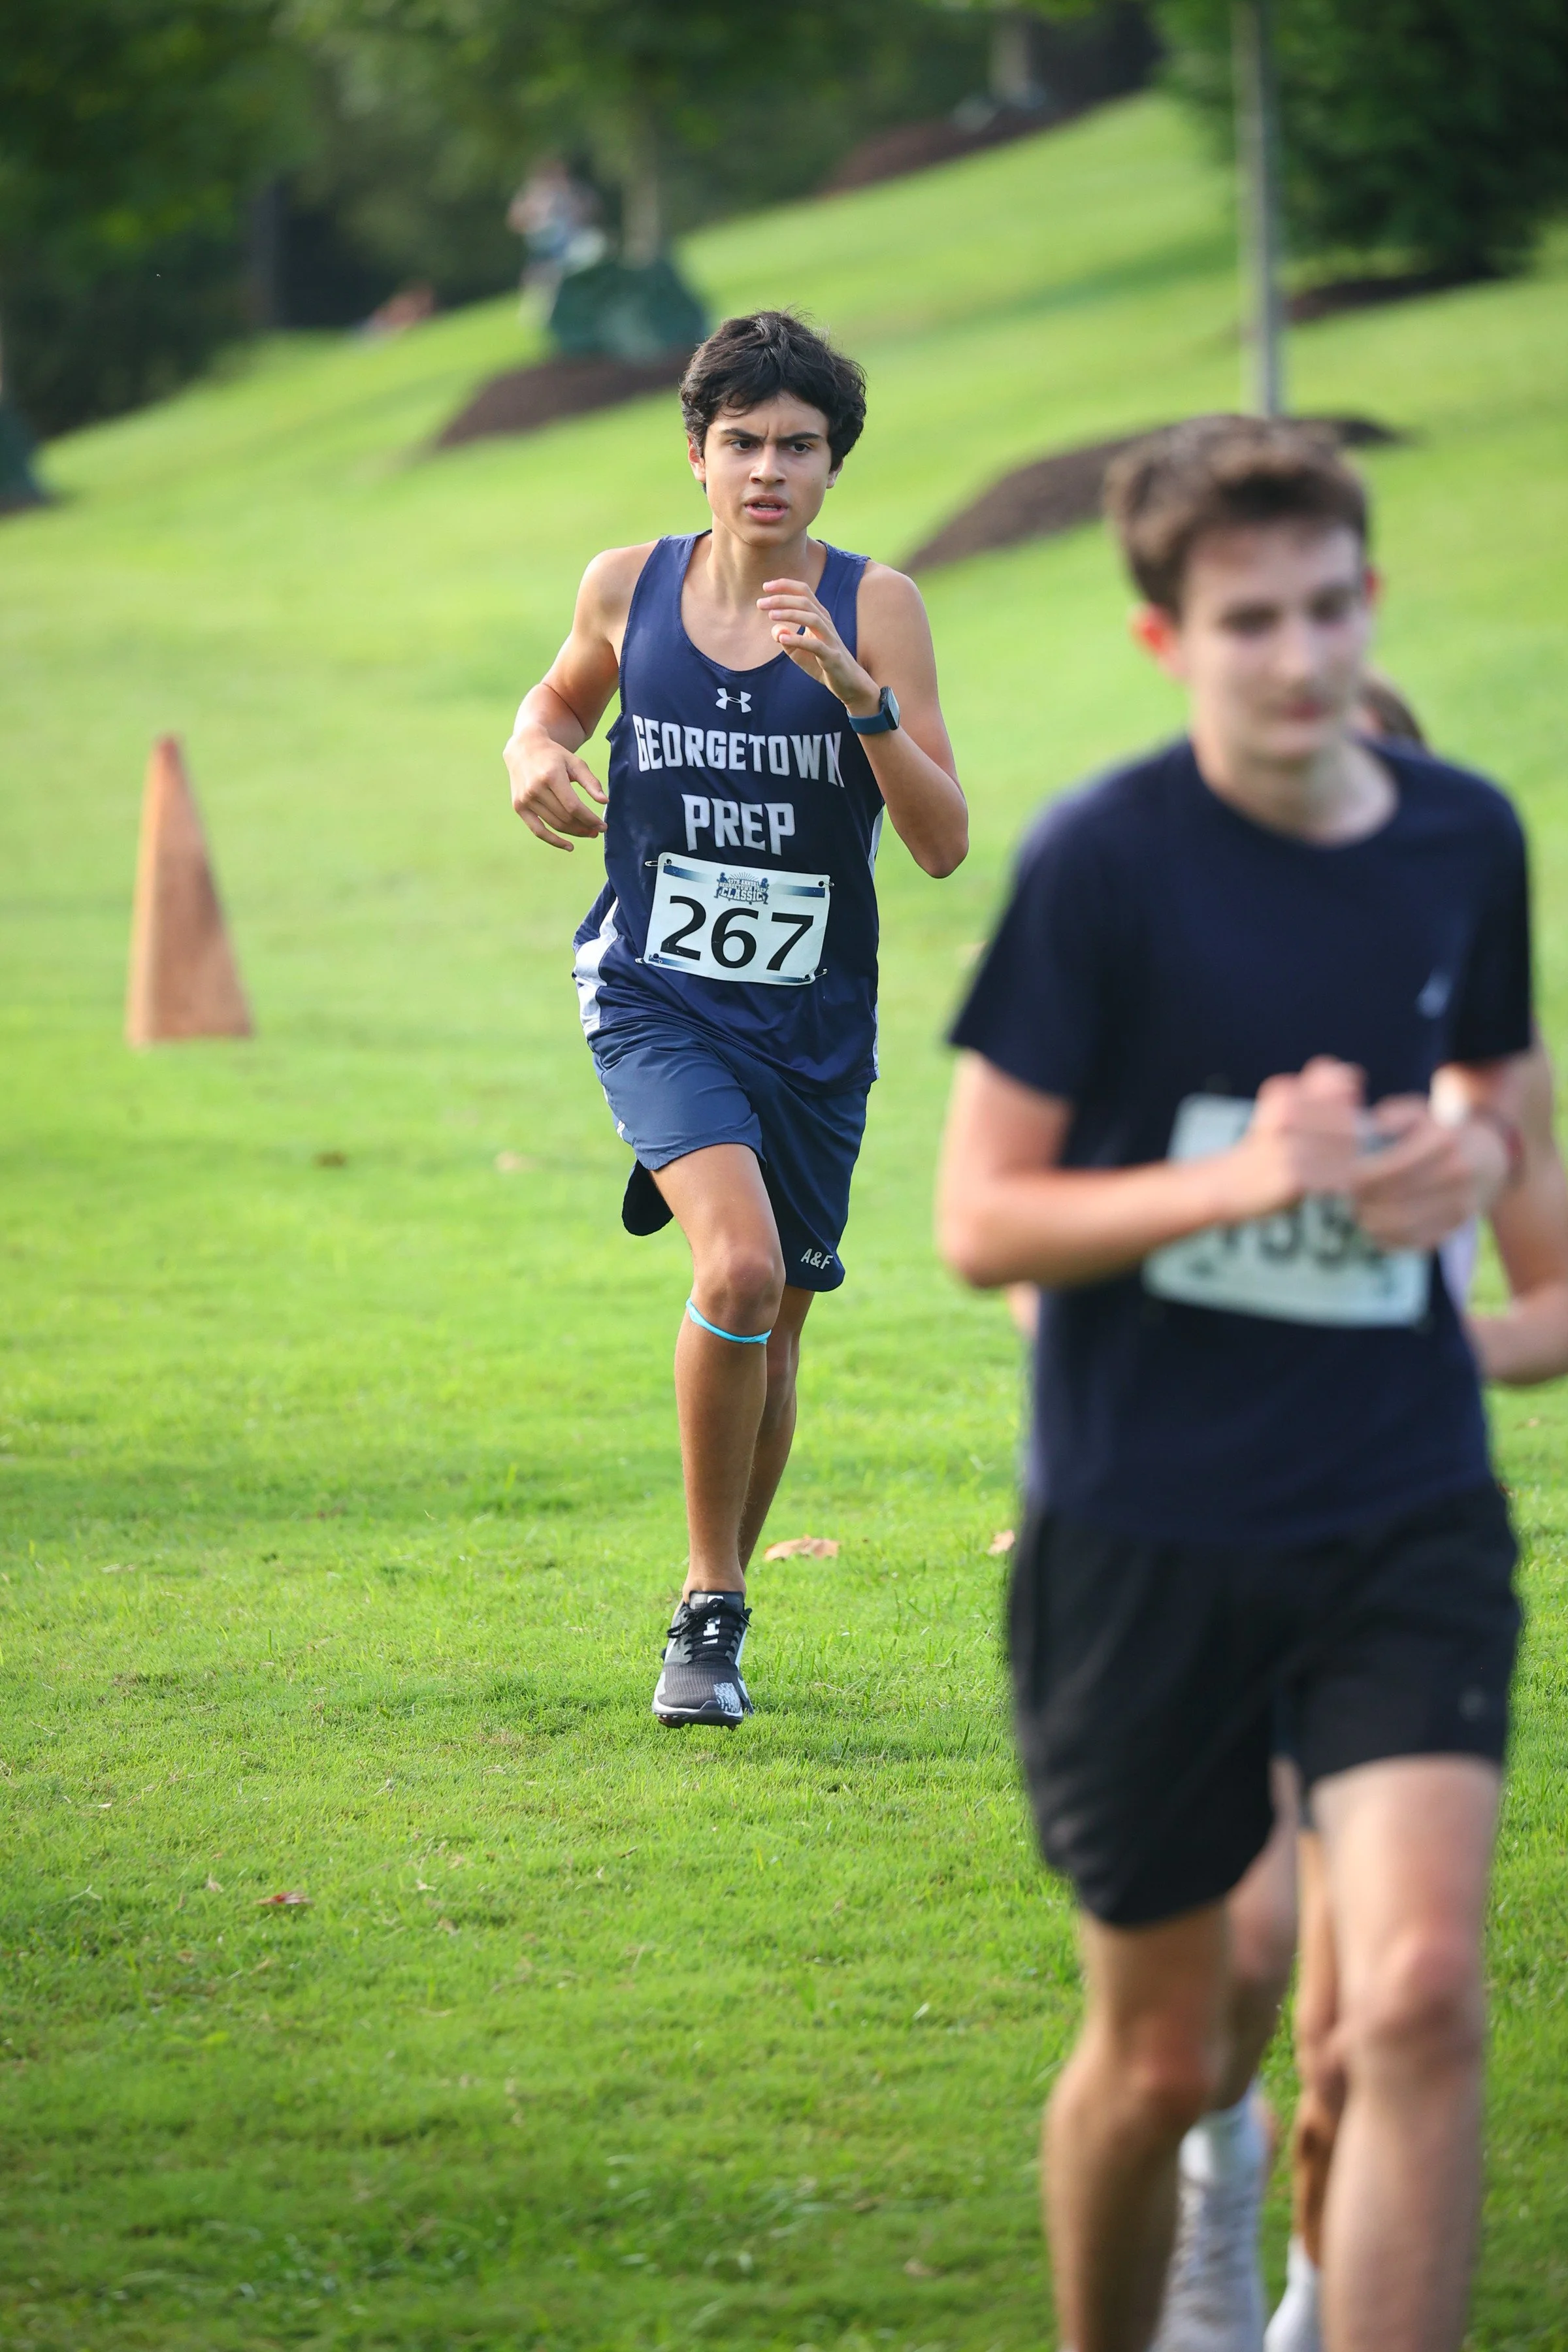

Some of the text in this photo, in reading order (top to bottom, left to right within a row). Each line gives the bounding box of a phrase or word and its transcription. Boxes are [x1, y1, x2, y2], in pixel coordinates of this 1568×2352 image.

[632, 714, 845, 788] GEORGETOWN
[681, 793, 796, 856] PREP
[719, 882, 753, 891] GEORGETOWN
[741, 879, 760, 887] ANNUAL
[720, 887, 763, 901] CLASSIC
[660, 895, 814, 971] 267
[800, 1248, 834, 1269] A&F
